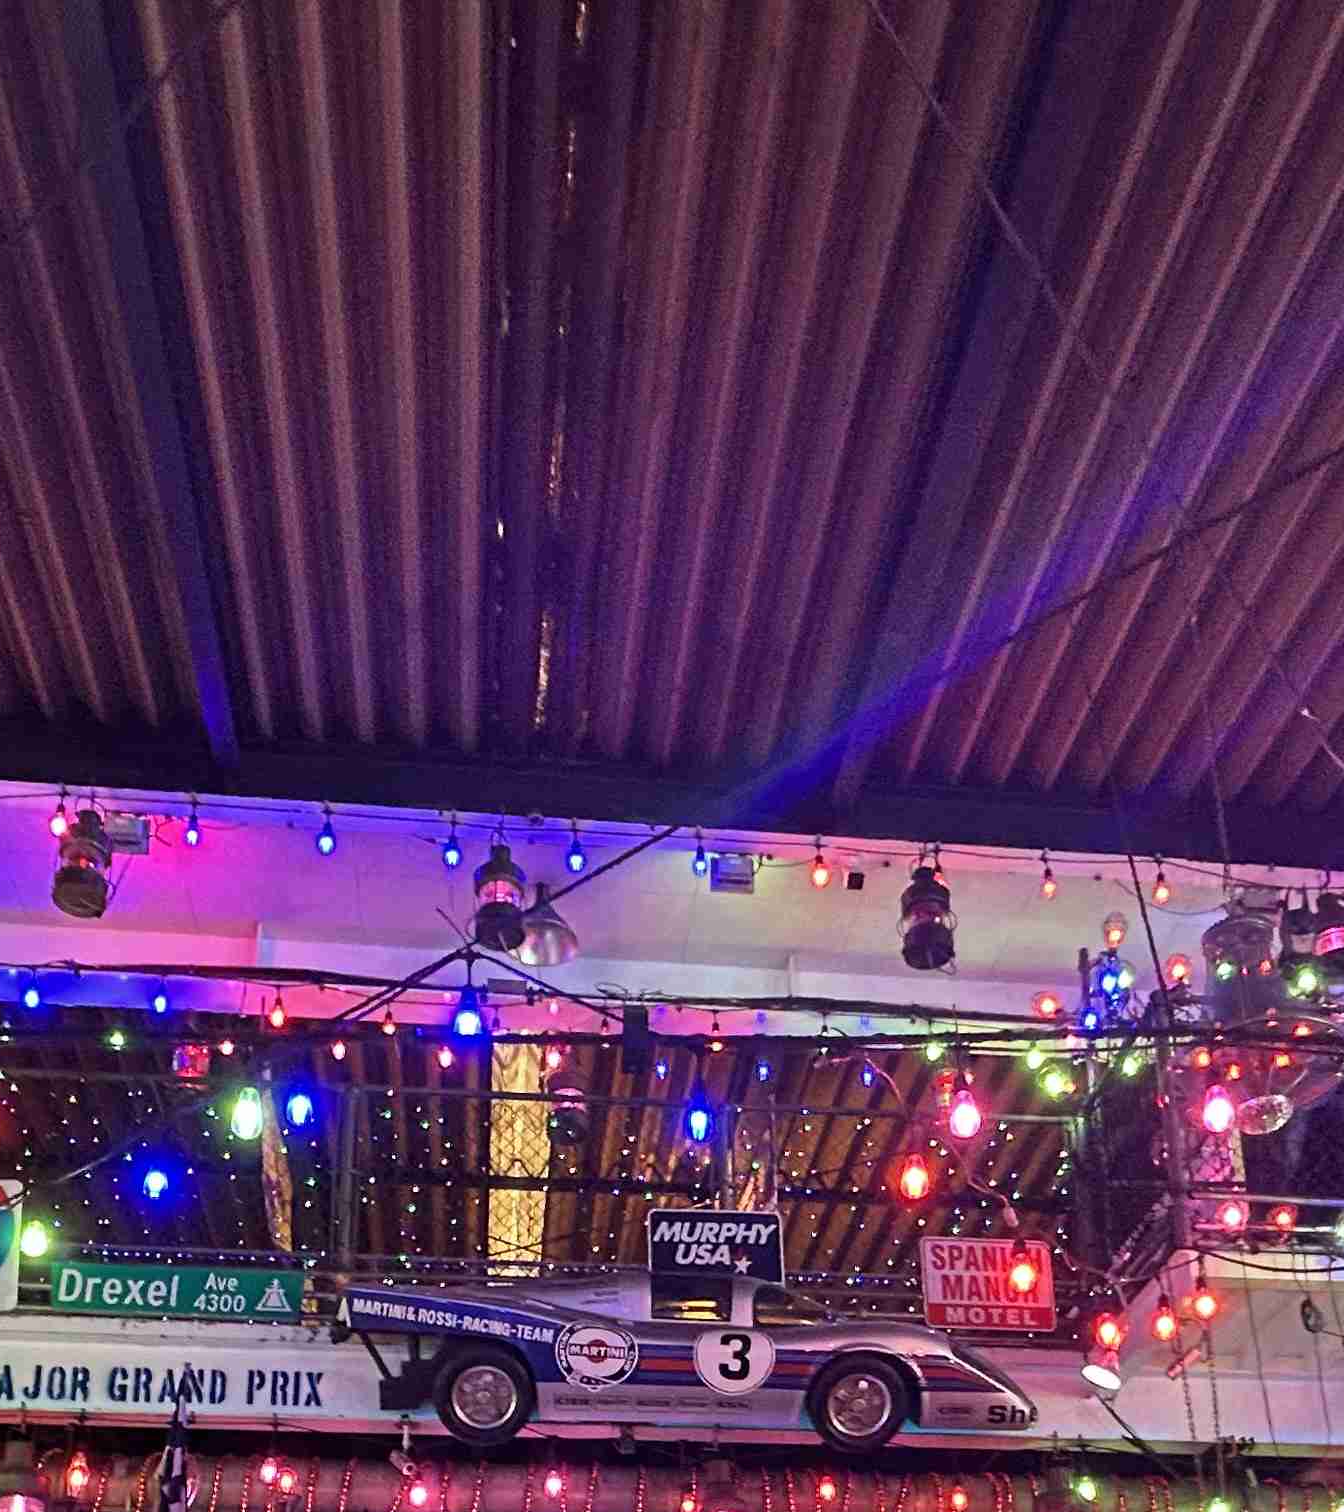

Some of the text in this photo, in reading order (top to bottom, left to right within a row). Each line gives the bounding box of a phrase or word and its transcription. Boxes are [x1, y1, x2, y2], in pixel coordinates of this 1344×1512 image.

[652, 1221, 777, 1245] MURPHY
[674, 1243, 732, 1266] USA
[930, 1243, 1043, 1273] SPANIH
[57, 1267, 239, 1307] Drexel Ave
[193, 1293, 246, 1313] 4300
[944, 1306, 1040, 1326] MOTEL
[568, 1343, 627, 1359] MARTINI
[718, 1333, 752, 1380] 3
[108, 1366, 228, 1404] GRAND
[246, 1369, 324, 1407] PRIX
